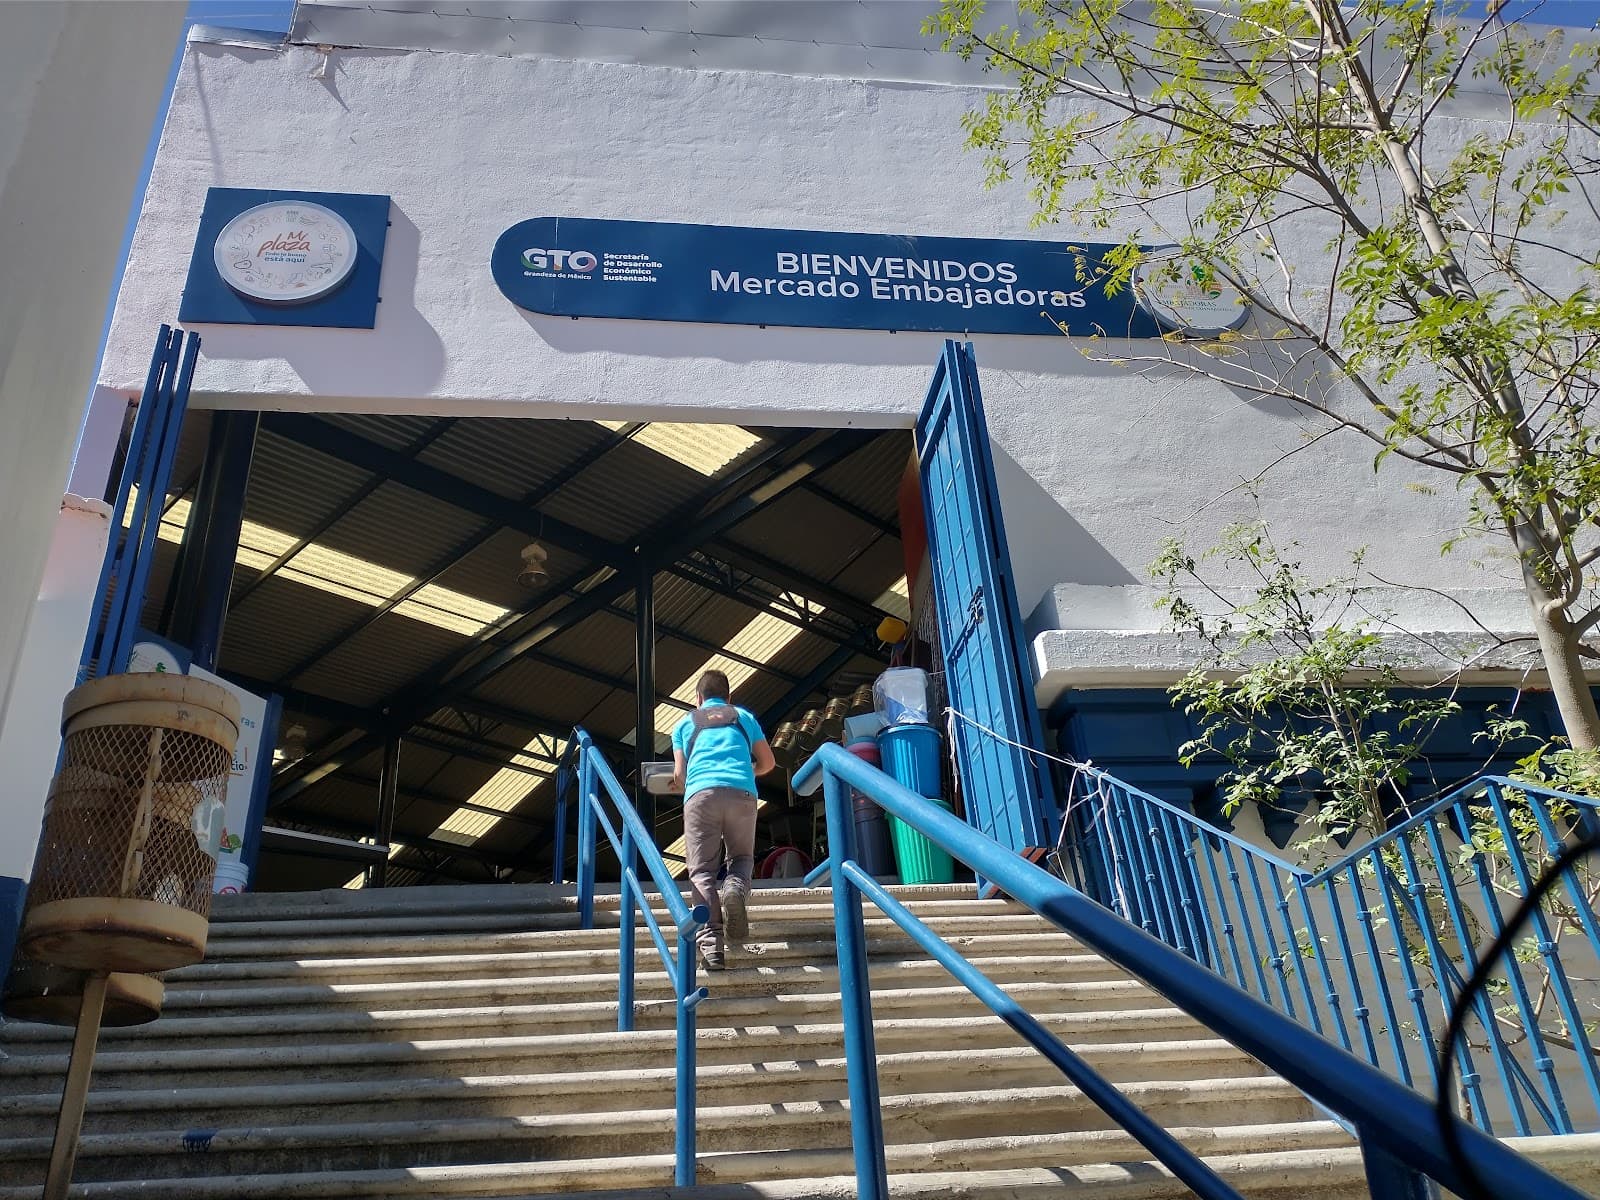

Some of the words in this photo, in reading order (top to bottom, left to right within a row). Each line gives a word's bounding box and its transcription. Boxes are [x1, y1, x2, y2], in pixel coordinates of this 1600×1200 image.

[287, 230, 309, 241] Mi
[257, 233, 311, 257] plaza
[521, 247, 598, 273] GTO
[603, 252, 650, 261] Secretaría
[616, 260, 663, 268] Desarrollo
[776, 252, 1018, 284] BIENVENIDOS
[523, 270, 557, 278] Grandeza
[603, 267, 651, 275] Económico
[603, 274, 657, 282] Sustentable
[710, 269, 860, 300] Mercado
[871, 277, 1087, 309] Embajadoras
